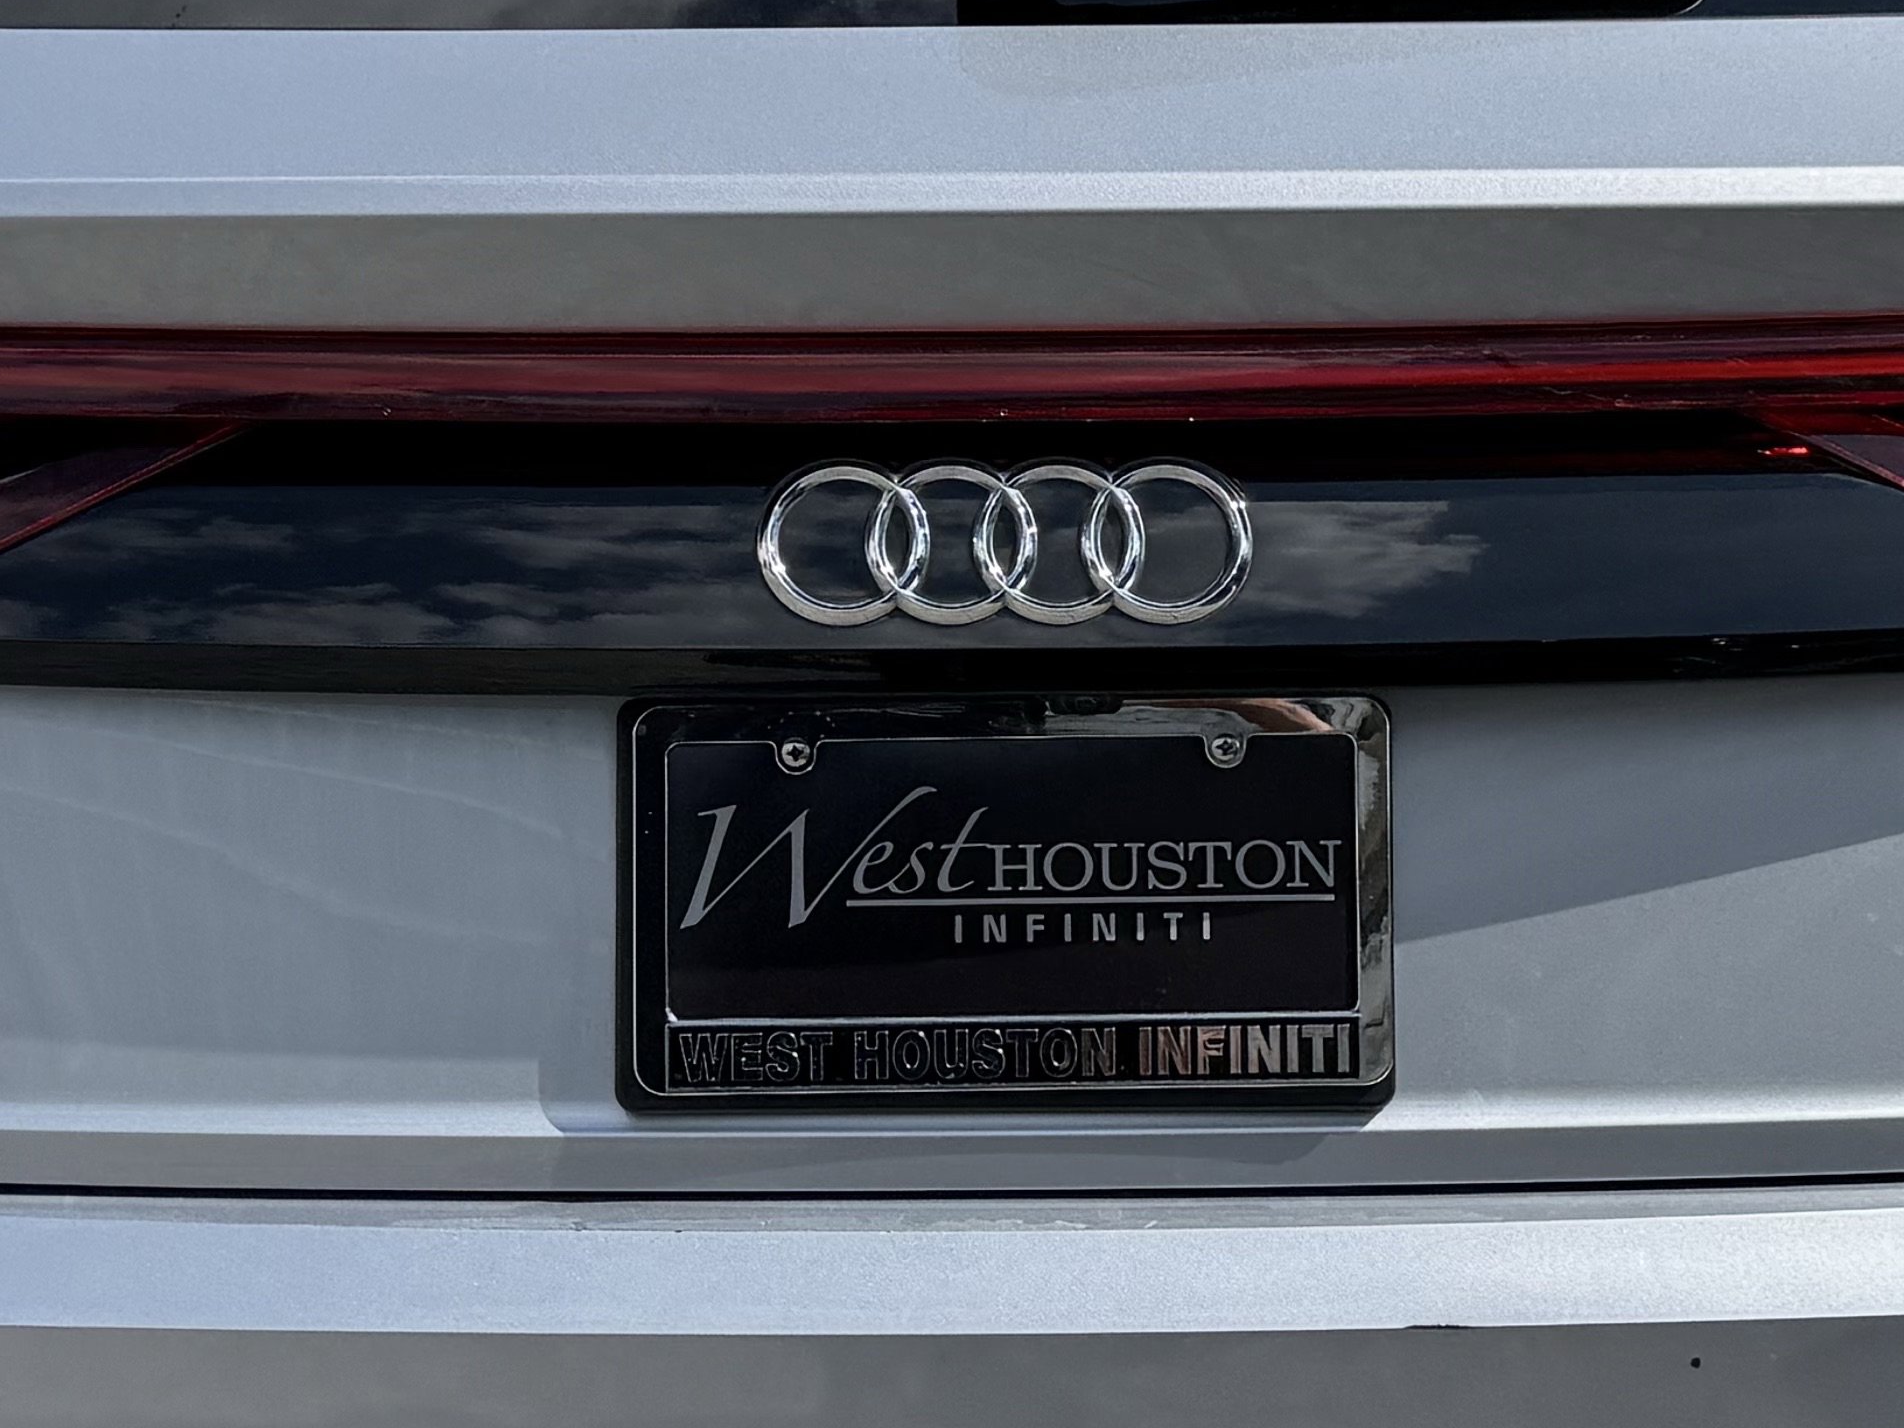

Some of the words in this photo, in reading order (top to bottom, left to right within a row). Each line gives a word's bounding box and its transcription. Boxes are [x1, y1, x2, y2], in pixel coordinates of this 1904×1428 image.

[679, 785, 996, 930] West
[986, 838, 1342, 892] HOUSTON
[953, 911, 1213, 944] INFINITI
[678, 1031, 834, 1083] WEST
[853, 1026, 1119, 1081] HOUSTON
[1136, 1022, 1352, 1077] INFINITI
